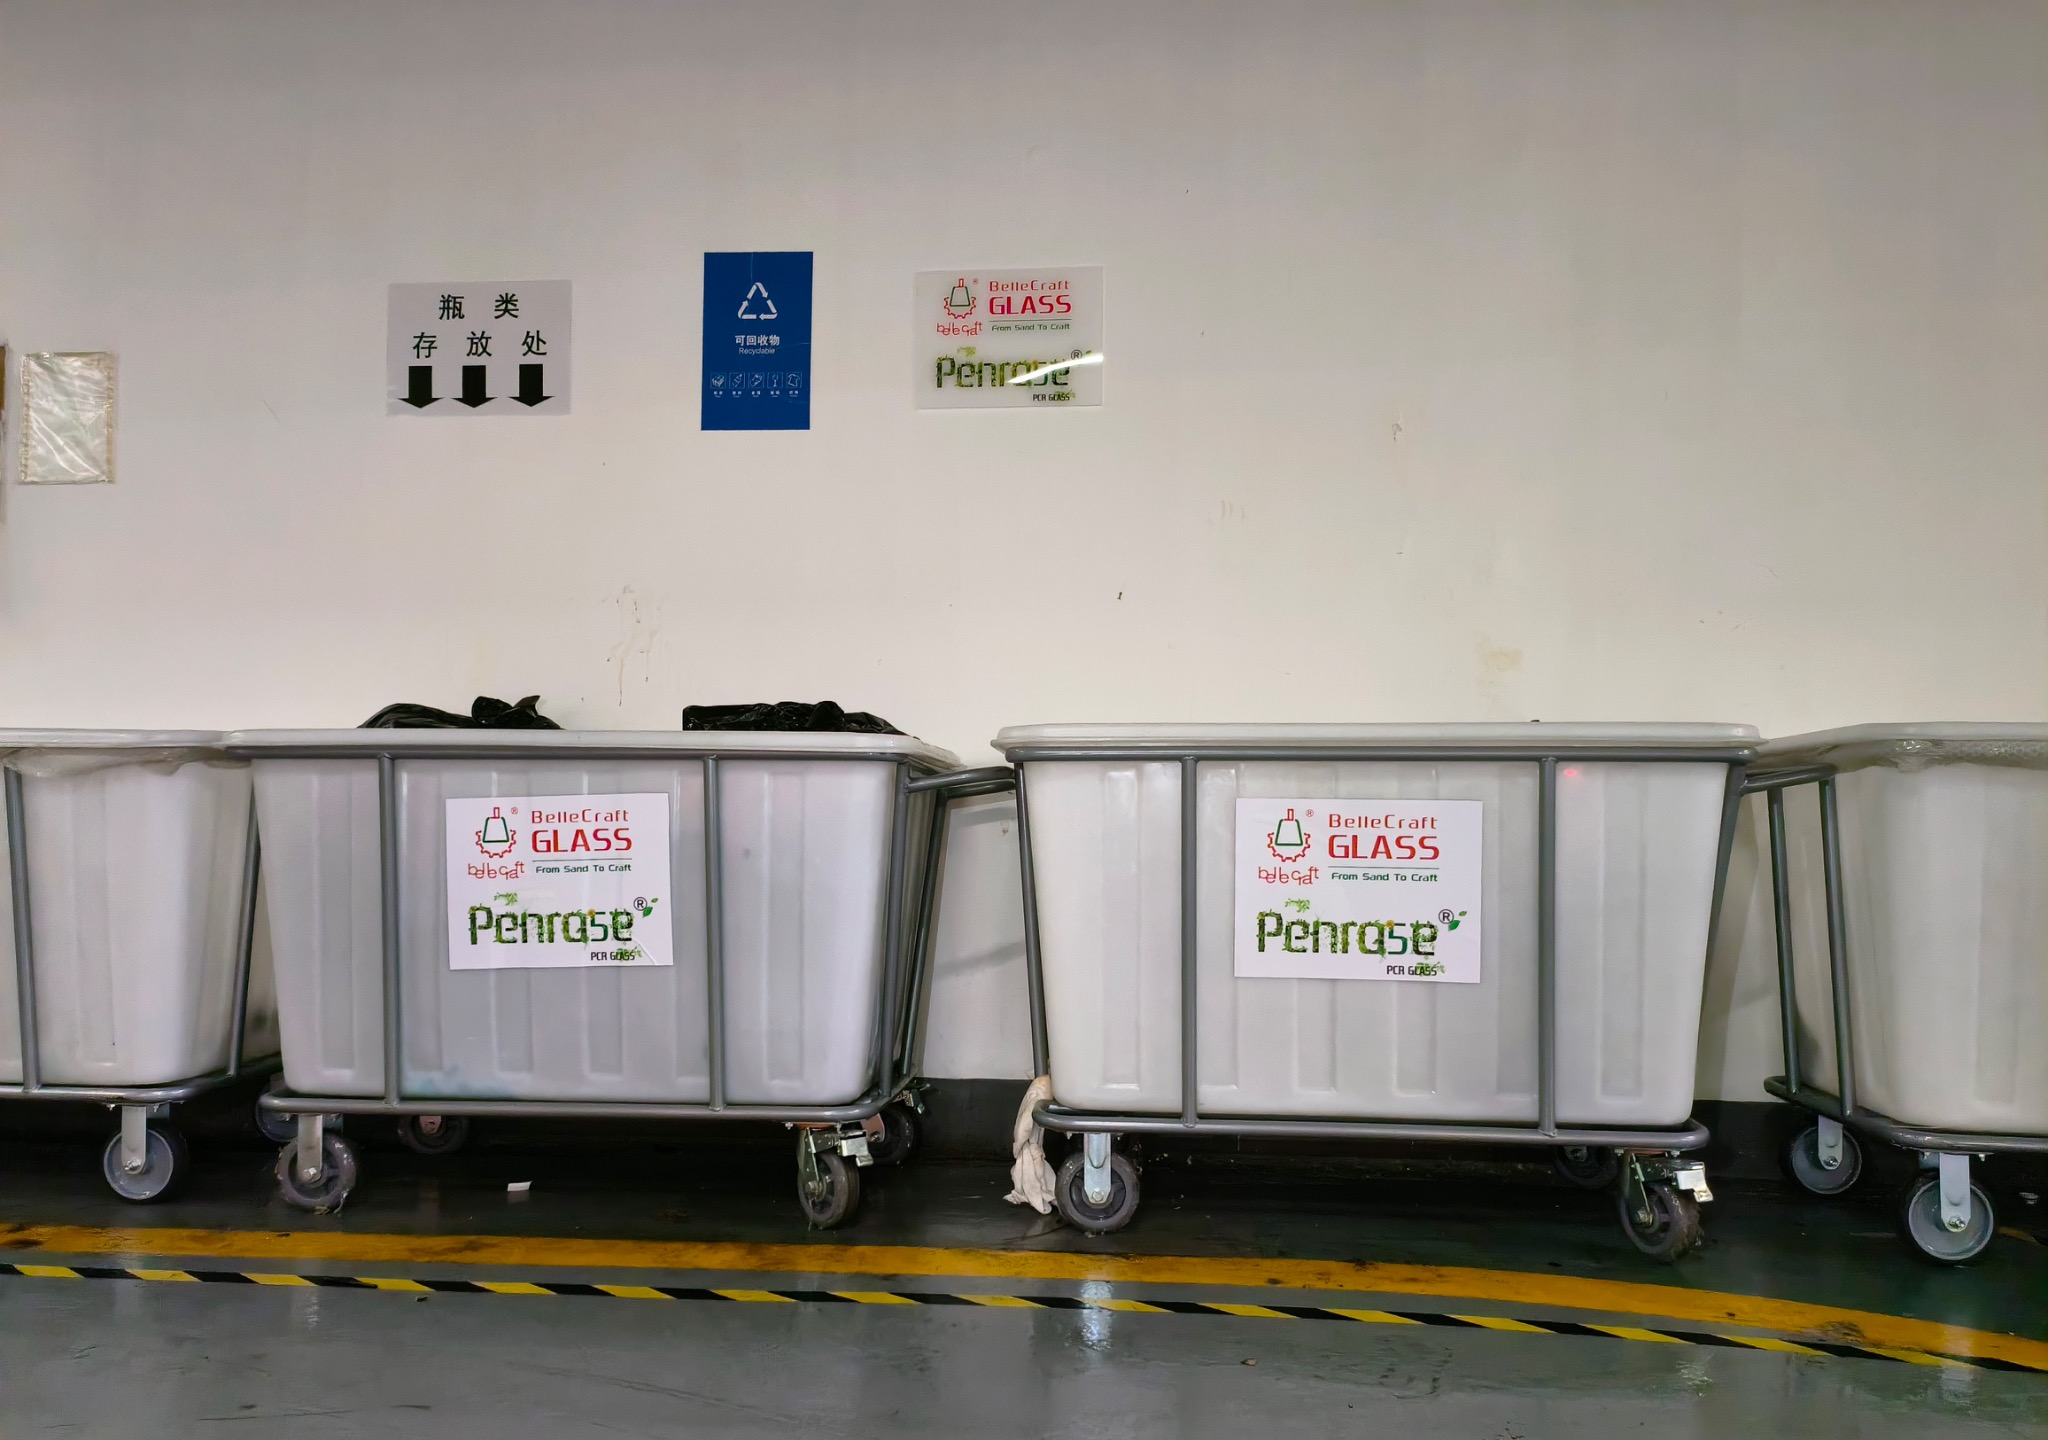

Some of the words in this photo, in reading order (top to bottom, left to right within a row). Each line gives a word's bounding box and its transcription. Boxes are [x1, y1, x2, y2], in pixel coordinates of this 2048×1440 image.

[989, 279, 1070, 292] BelleCraft
[438, 293, 520, 321] 瓶类
[989, 295, 1072, 315] GLASS
[412, 330, 548, 358] 存放处
[735, 334, 780, 346] 可回收物
[738, 347, 776, 355] Recyclable
[1033, 394, 1046, 402] PCR
[531, 808, 629, 824] BelleCraft
[1328, 813, 1438, 829] BelleCraft
[531, 828, 633, 853] GLASS
[1328, 834, 1440, 860] GLASS
[535, 865, 560, 874] From
[563, 864, 588, 873] Sand
[593, 864, 605, 872] To
[608, 864, 631, 872] Craft
[1331, 872, 1358, 881] From
[1362, 873, 1389, 881] Sand
[1394, 873, 1407, 881] To
[1411, 873, 1438, 882] Craft
[468, 905, 635, 945] Penrose
[1256, 911, 1438, 956] Penrose
[590, 951, 607, 961] PCR
[610, 951, 635, 961] GLASS
[1386, 965, 1404, 975] PCR
[1408, 965, 1437, 976] GLASS
